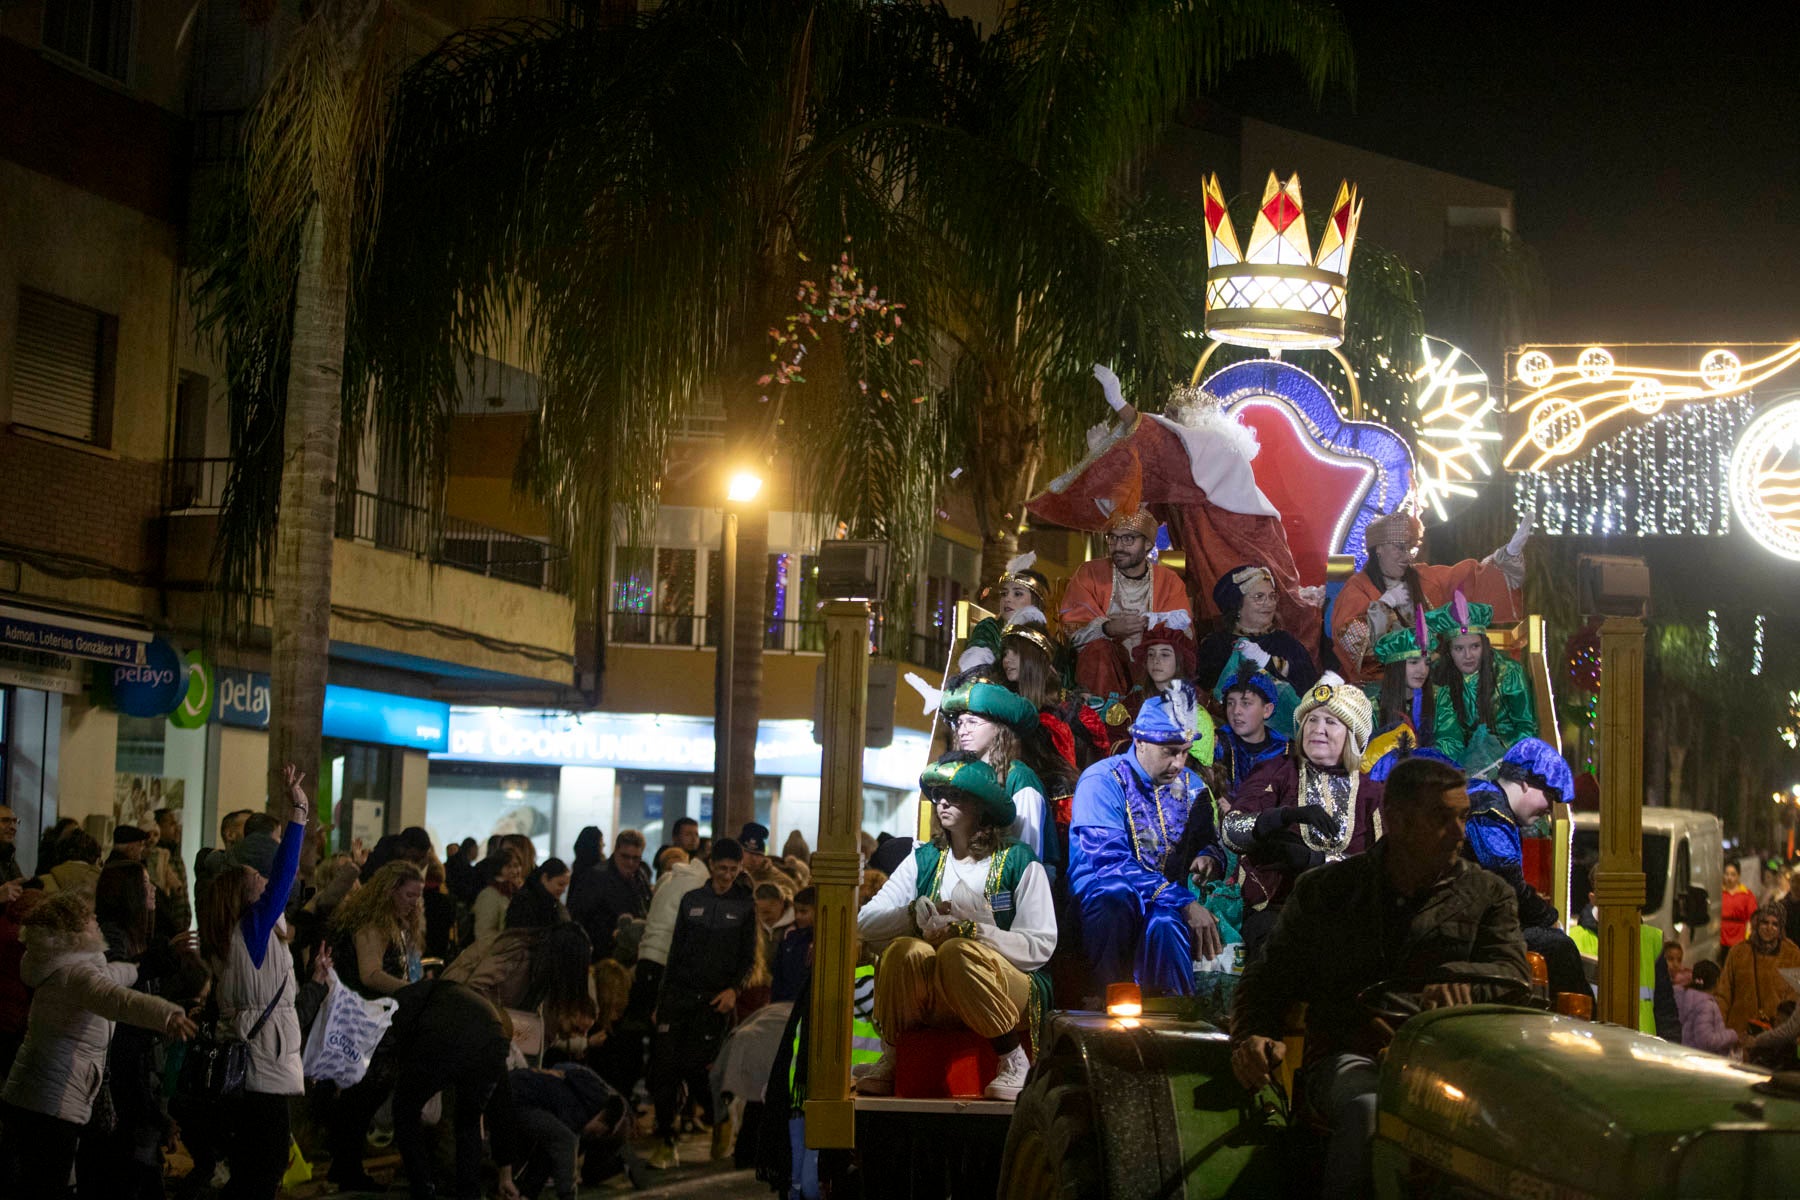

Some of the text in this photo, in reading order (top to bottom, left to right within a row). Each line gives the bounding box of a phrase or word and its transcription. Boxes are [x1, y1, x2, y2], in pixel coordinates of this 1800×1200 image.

[114, 667, 174, 688] pelayo
[219, 674, 271, 725] pelay
[451, 730, 485, 754] DE
[492, 727, 715, 764] OPORTUNIDADE
